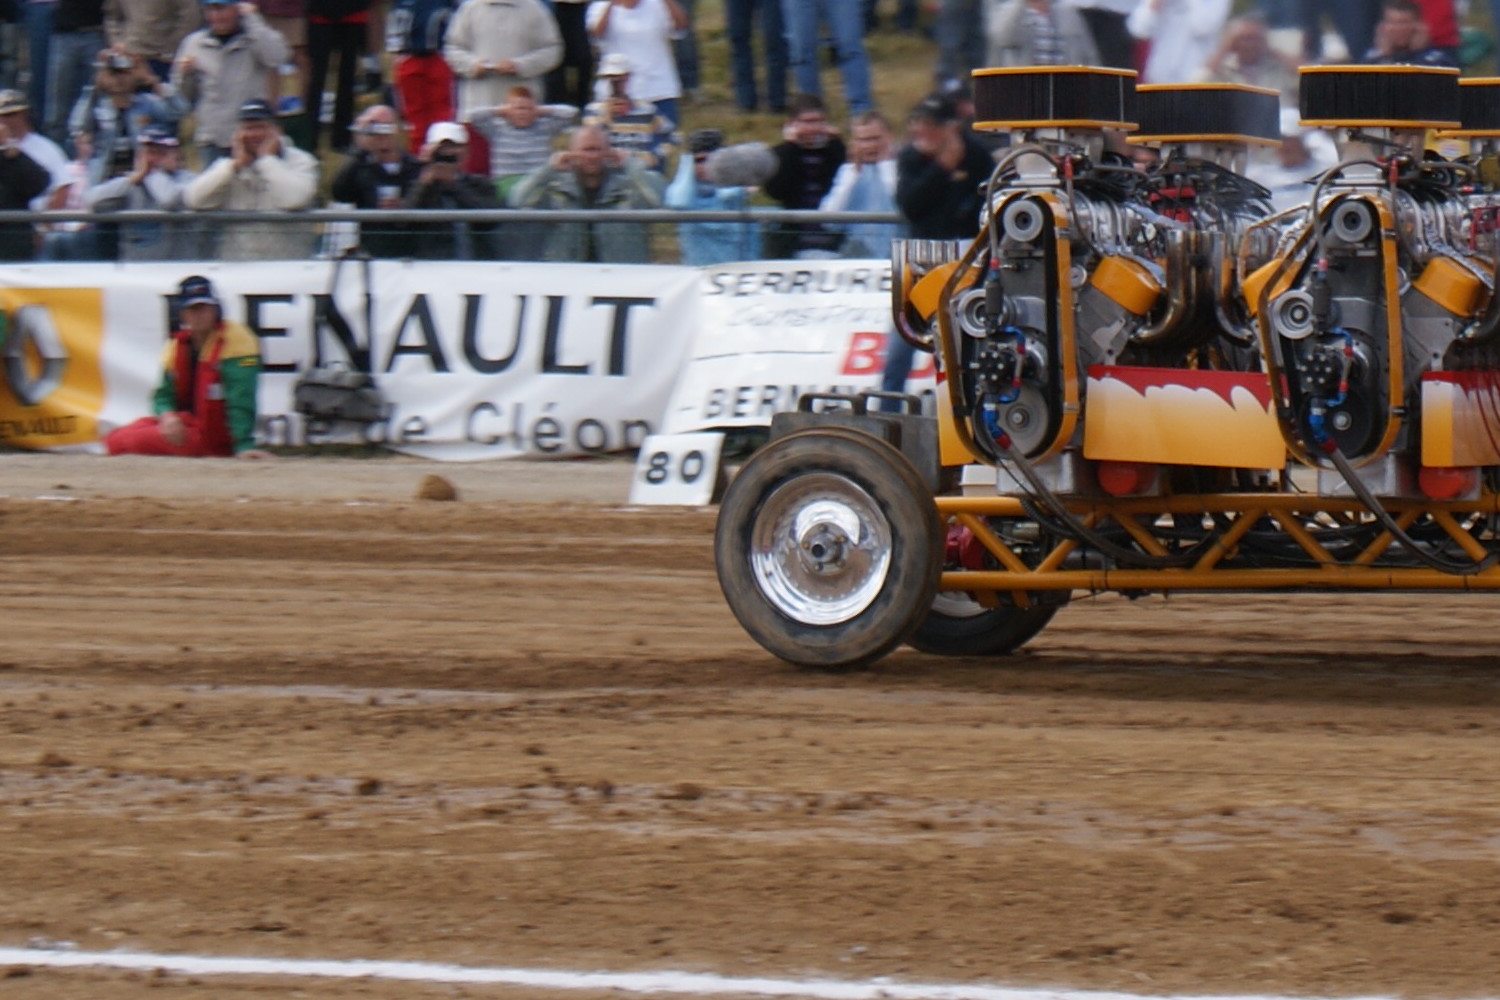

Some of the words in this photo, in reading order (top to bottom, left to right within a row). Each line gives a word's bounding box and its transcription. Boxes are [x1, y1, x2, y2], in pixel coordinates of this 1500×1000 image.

[163, 291, 658, 377] ENAULT
[466, 400, 652, 452] Cléon
[645, 450, 704, 485] 80
